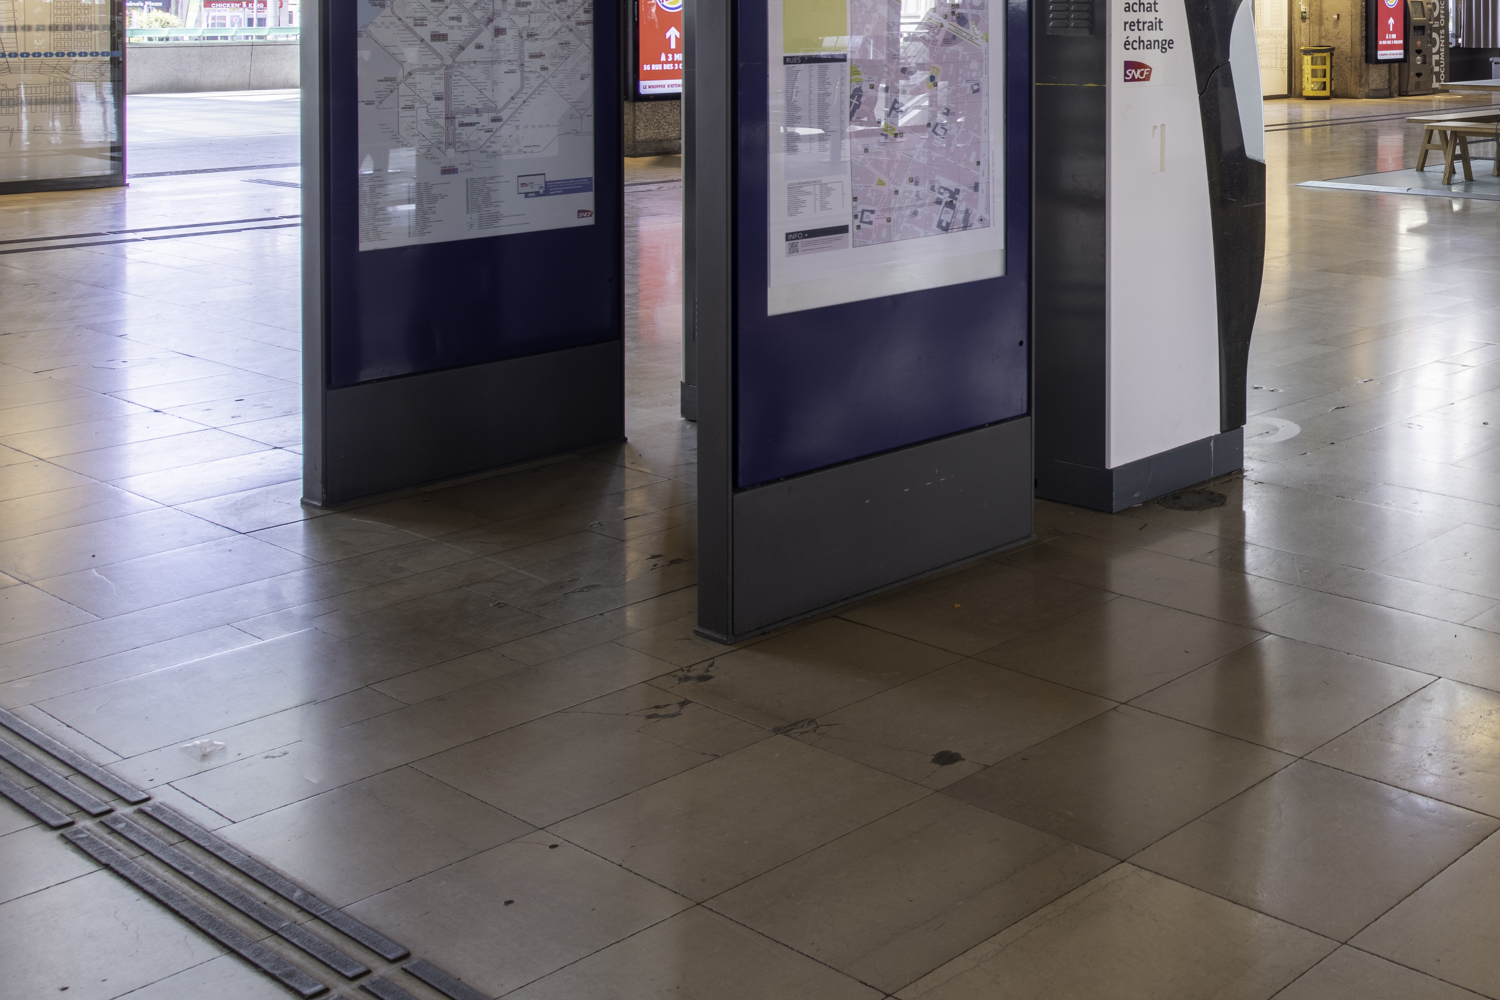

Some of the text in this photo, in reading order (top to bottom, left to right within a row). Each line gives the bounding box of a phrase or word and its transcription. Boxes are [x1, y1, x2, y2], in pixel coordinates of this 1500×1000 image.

[1123, 17, 1163, 32] retrait
[1123, 36, 1175, 53] échange
[660, 52, 667, 62] À
[667, 53, 673, 62] 3
[785, 56, 802, 64] RUES
[1124, 68, 1151, 80] SNCF
[787, 232, 804, 241] INFO
